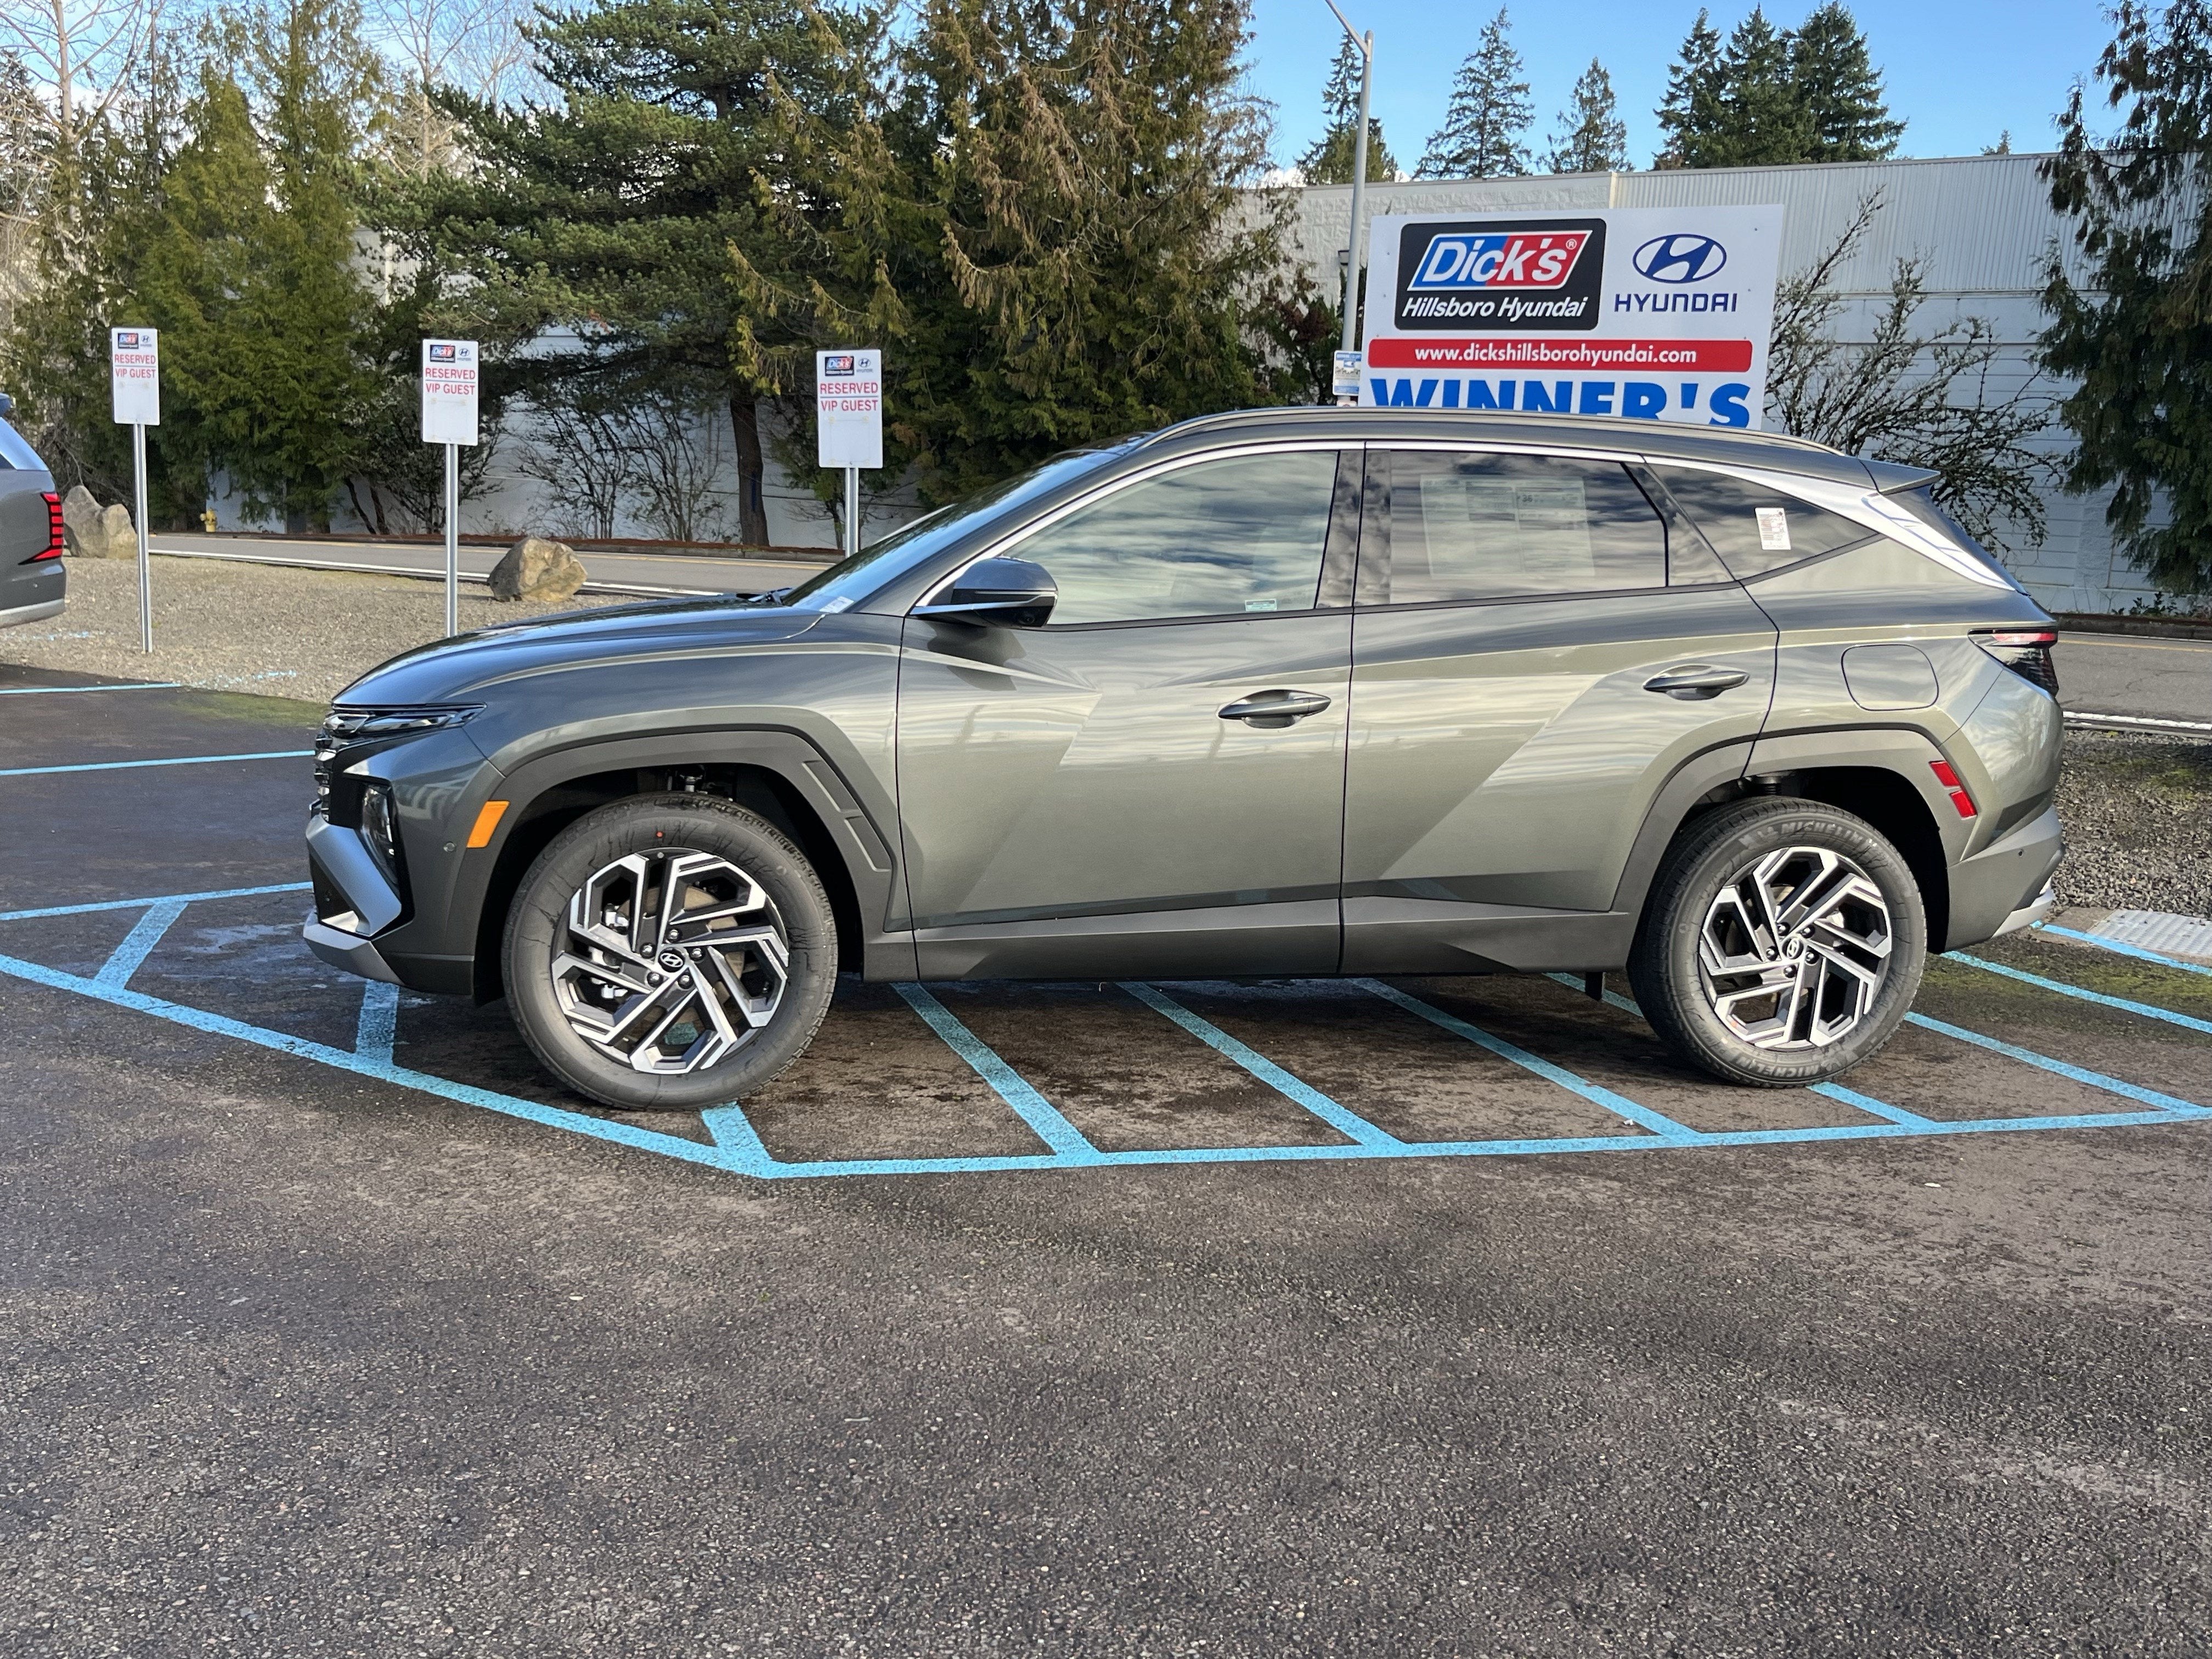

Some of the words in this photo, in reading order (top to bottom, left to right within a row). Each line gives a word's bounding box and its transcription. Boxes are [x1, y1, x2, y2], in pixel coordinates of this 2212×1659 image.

[1615, 293, 1737, 312] HYUNDAI
[1402, 297, 1494, 318] Hillsboro
[1497, 296, 1588, 322] Hyundai
[114, 354, 156, 364] RESERVED
[1415, 342, 1696, 366] www.dickshillsborohyundai.com
[115, 368, 127, 377] VIP
[129, 369, 156, 379] GUEST
[425, 368, 476, 380] RESERVED
[426, 383, 441, 393] VIP
[443, 384, 476, 395] GUEST
[820, 382, 878, 394] RESERVED
[821, 400, 838, 411] VIP
[842, 399, 878, 411] GUEST
[1781, 822, 1864, 844] MICHELIN
[1736, 1056, 1819, 1077] MICHELIN
